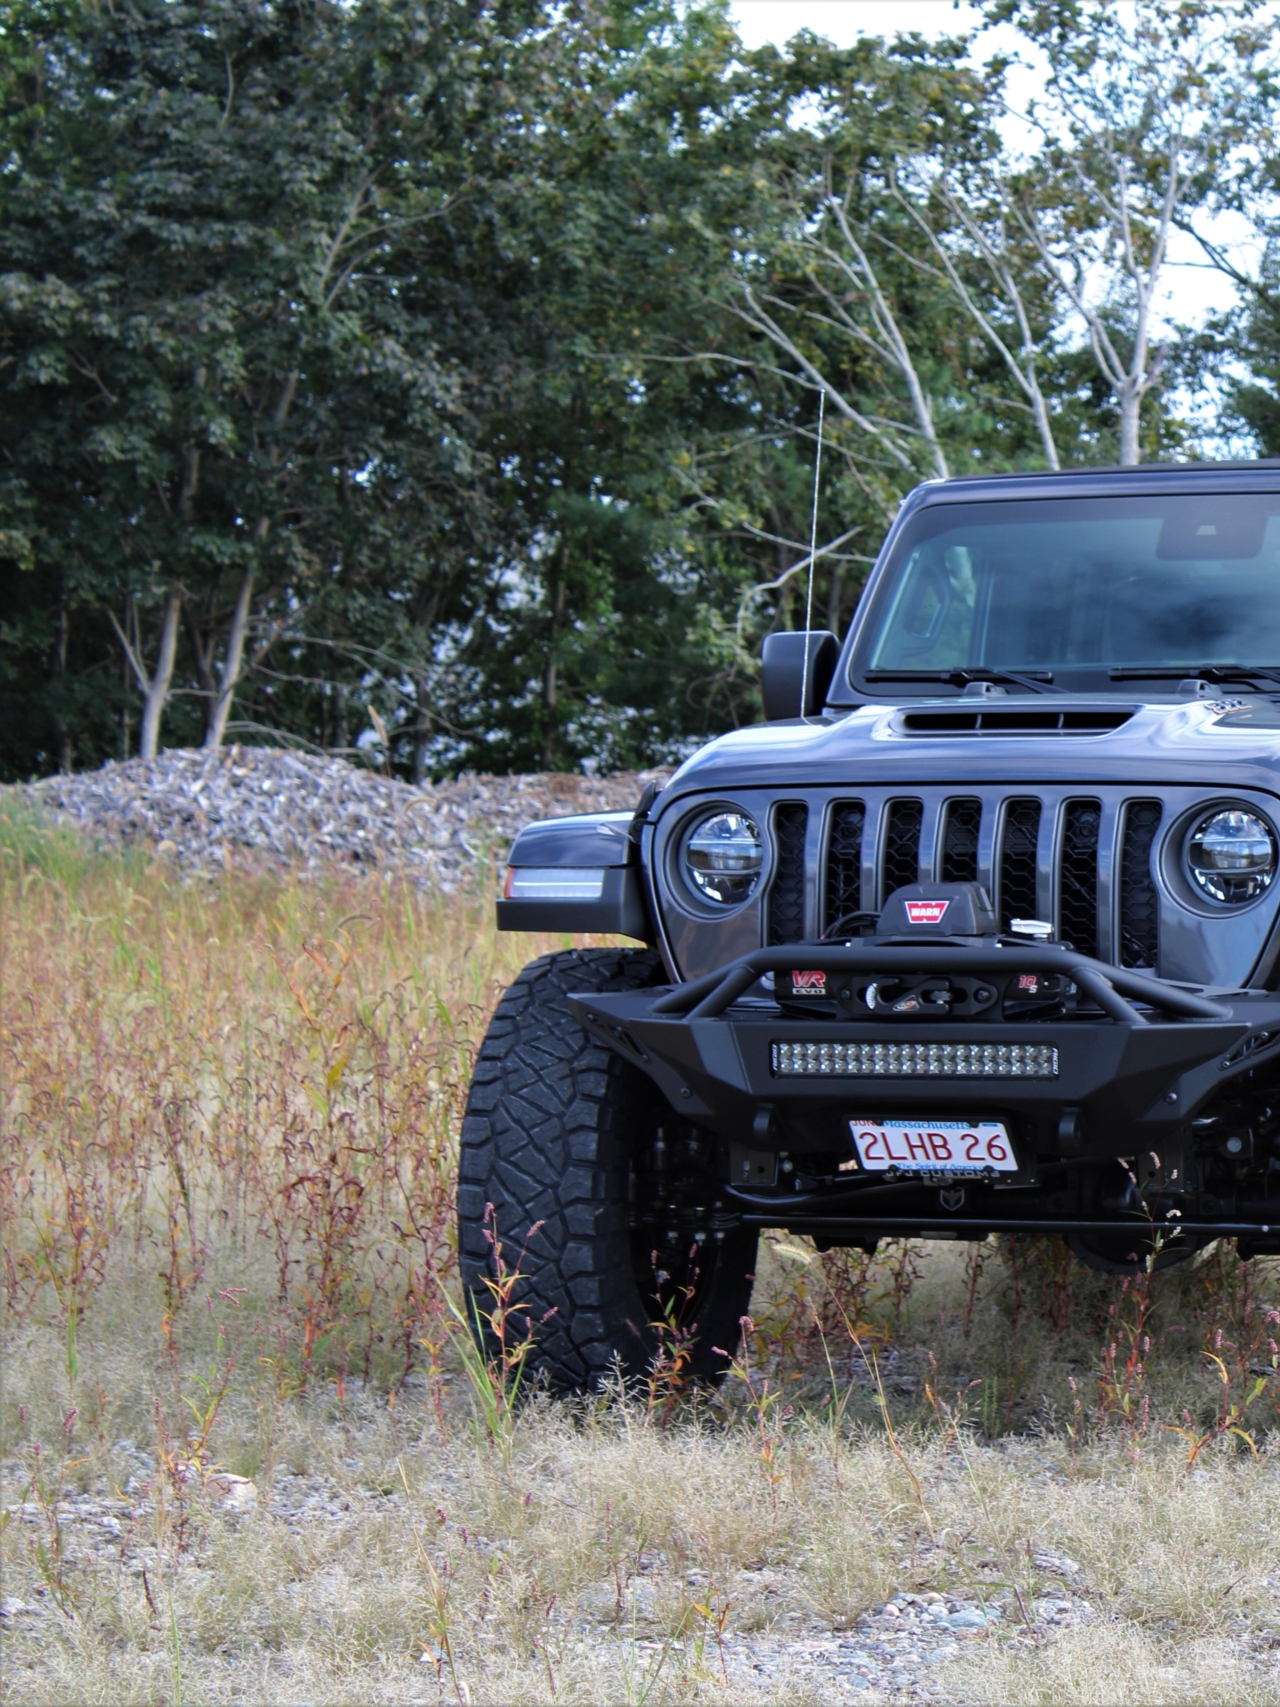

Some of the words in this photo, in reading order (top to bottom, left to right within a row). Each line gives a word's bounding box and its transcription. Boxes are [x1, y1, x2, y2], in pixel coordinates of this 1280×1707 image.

[910, 907, 940, 917] WARN
[792, 970, 826, 988] VR
[883, 1121, 971, 1130] Massachusetts
[859, 1131, 953, 1161] 2LHB
[960, 1133, 1007, 1161] 26
